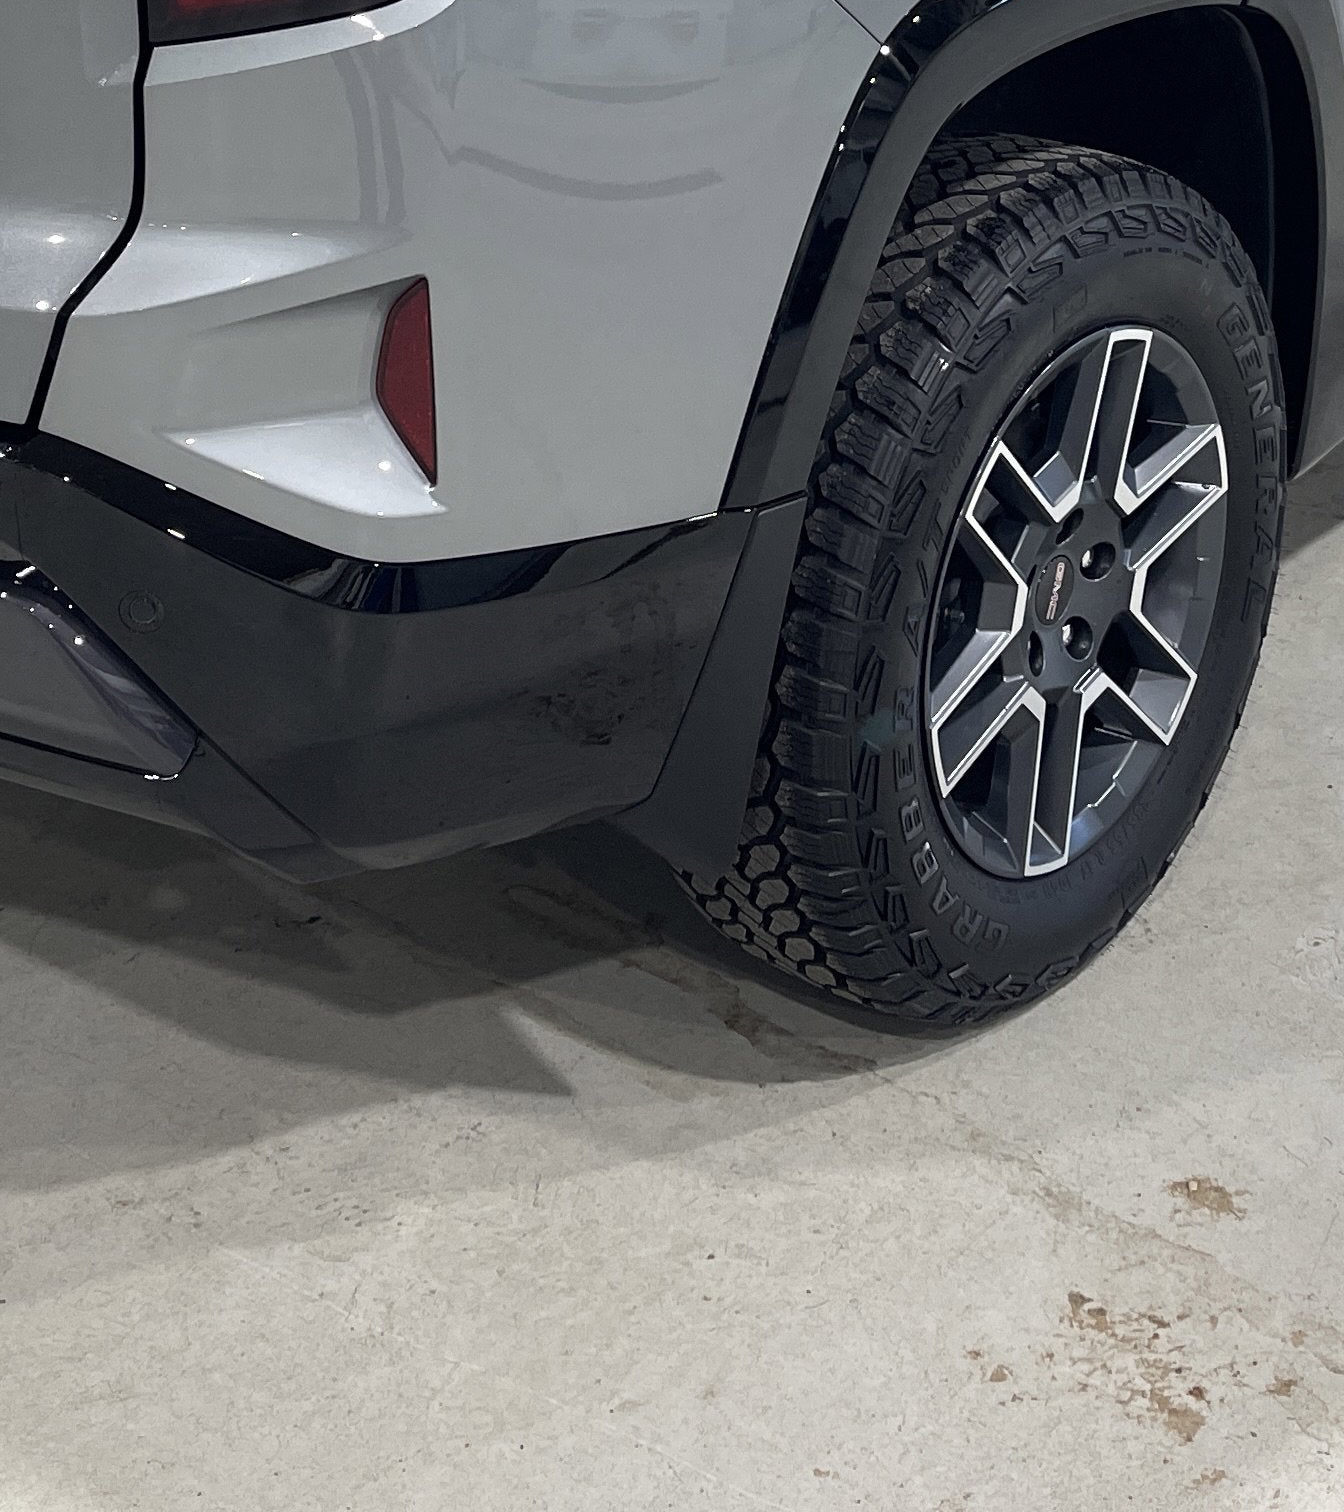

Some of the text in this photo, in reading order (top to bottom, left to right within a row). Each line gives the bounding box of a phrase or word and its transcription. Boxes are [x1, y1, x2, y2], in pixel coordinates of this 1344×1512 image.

[1046, 560, 1066, 621] GMC
[1216, 303, 1277, 622] GENERAL
[894, 687, 1010, 951] GRABBER
